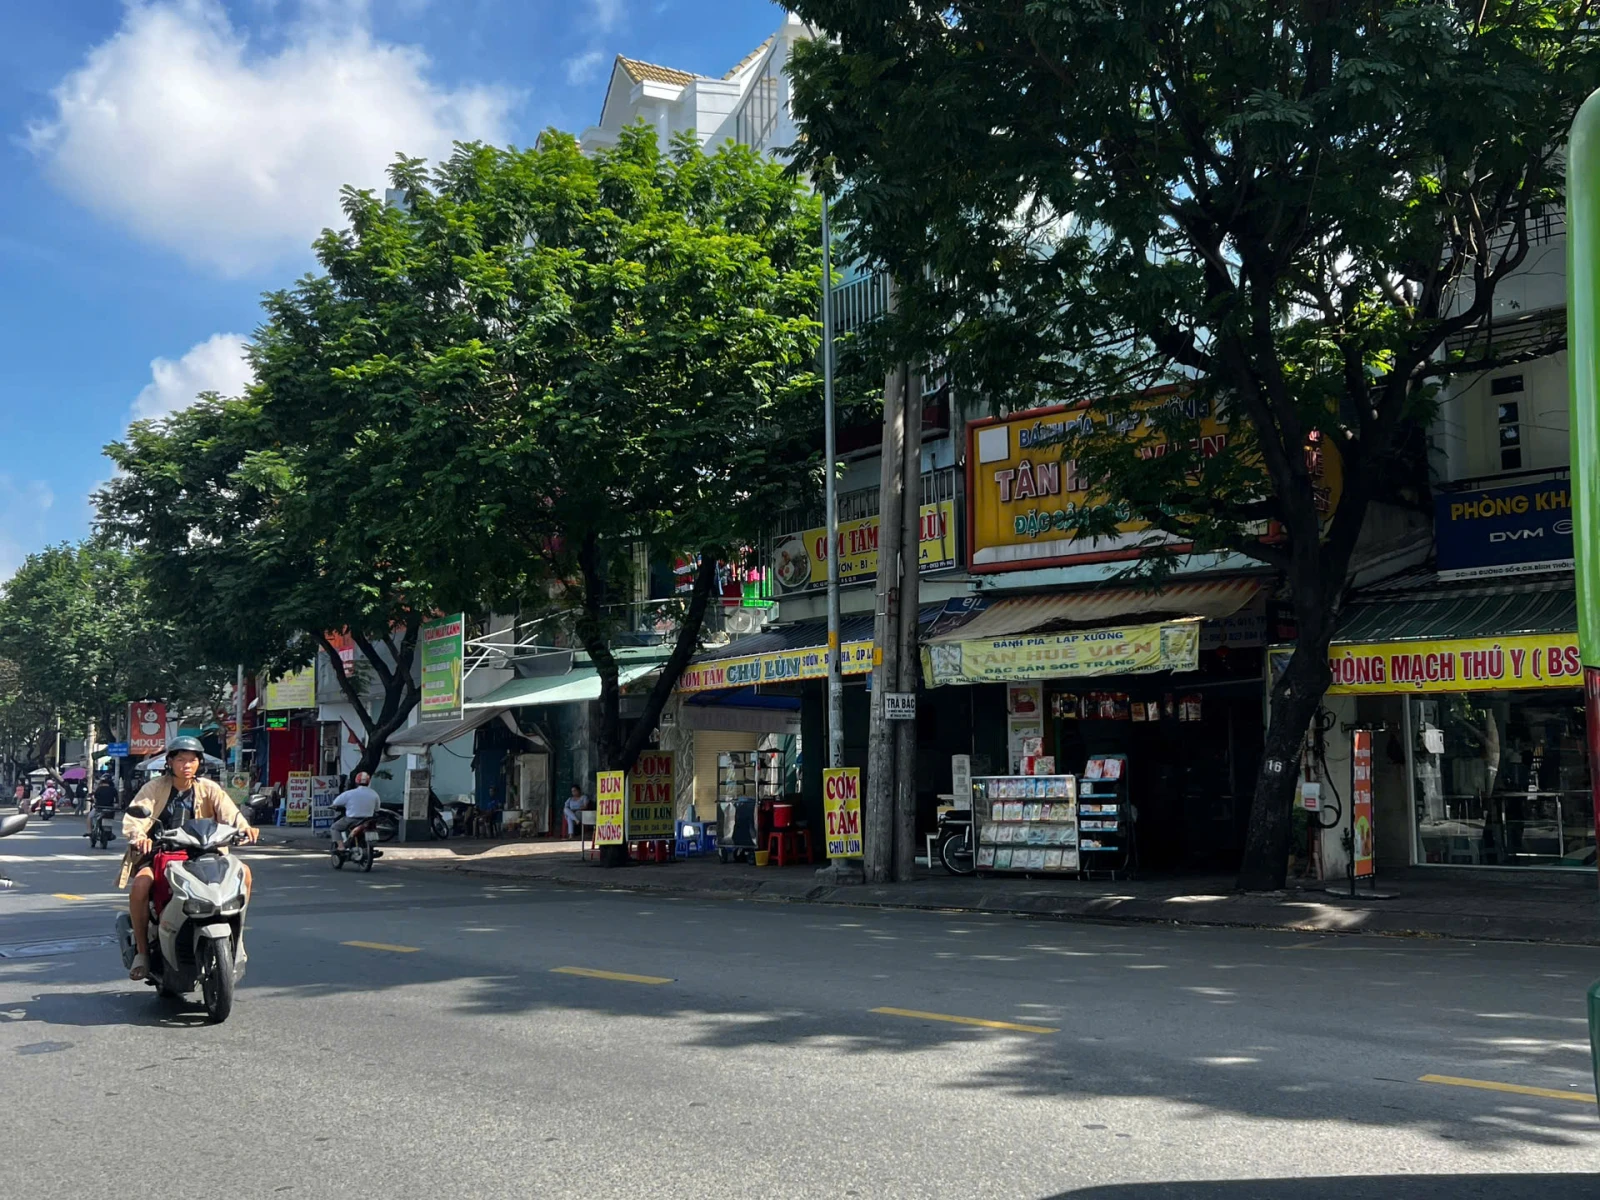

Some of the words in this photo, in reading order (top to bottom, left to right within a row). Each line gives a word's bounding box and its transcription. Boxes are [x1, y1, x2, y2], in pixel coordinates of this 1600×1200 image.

[995, 459, 1059, 503] TÂN
[1451, 494, 1529, 520] PHÒNG
[849, 521, 878, 556] TẤM
[920, 510, 947, 543] LÙN
[1014, 508, 1050, 538] ĐẶC
[1490, 528, 1543, 542] DVM
[727, 657, 761, 684] CHÚ
[764, 655, 801, 681] LÙN
[1391, 652, 1455, 689] MẠCH
[1460, 645, 1503, 682] THÚ
[1510, 649, 1524, 678] Y
[131, 738, 165, 747] MIXUE
[1267, 759, 1283, 773] 16
[600, 773, 621, 793] BÚN
[632, 778, 671, 804] TẤM
[826, 771, 857, 800] CƠM
[289, 798, 308, 810] GẤP
[599, 799, 621, 819] THỊT
[597, 820, 622, 841] NƯỚNG
[827, 800, 859, 835] TẤM
[828, 838, 844, 854] CHÚ
[846, 837, 861, 853] LÙN
